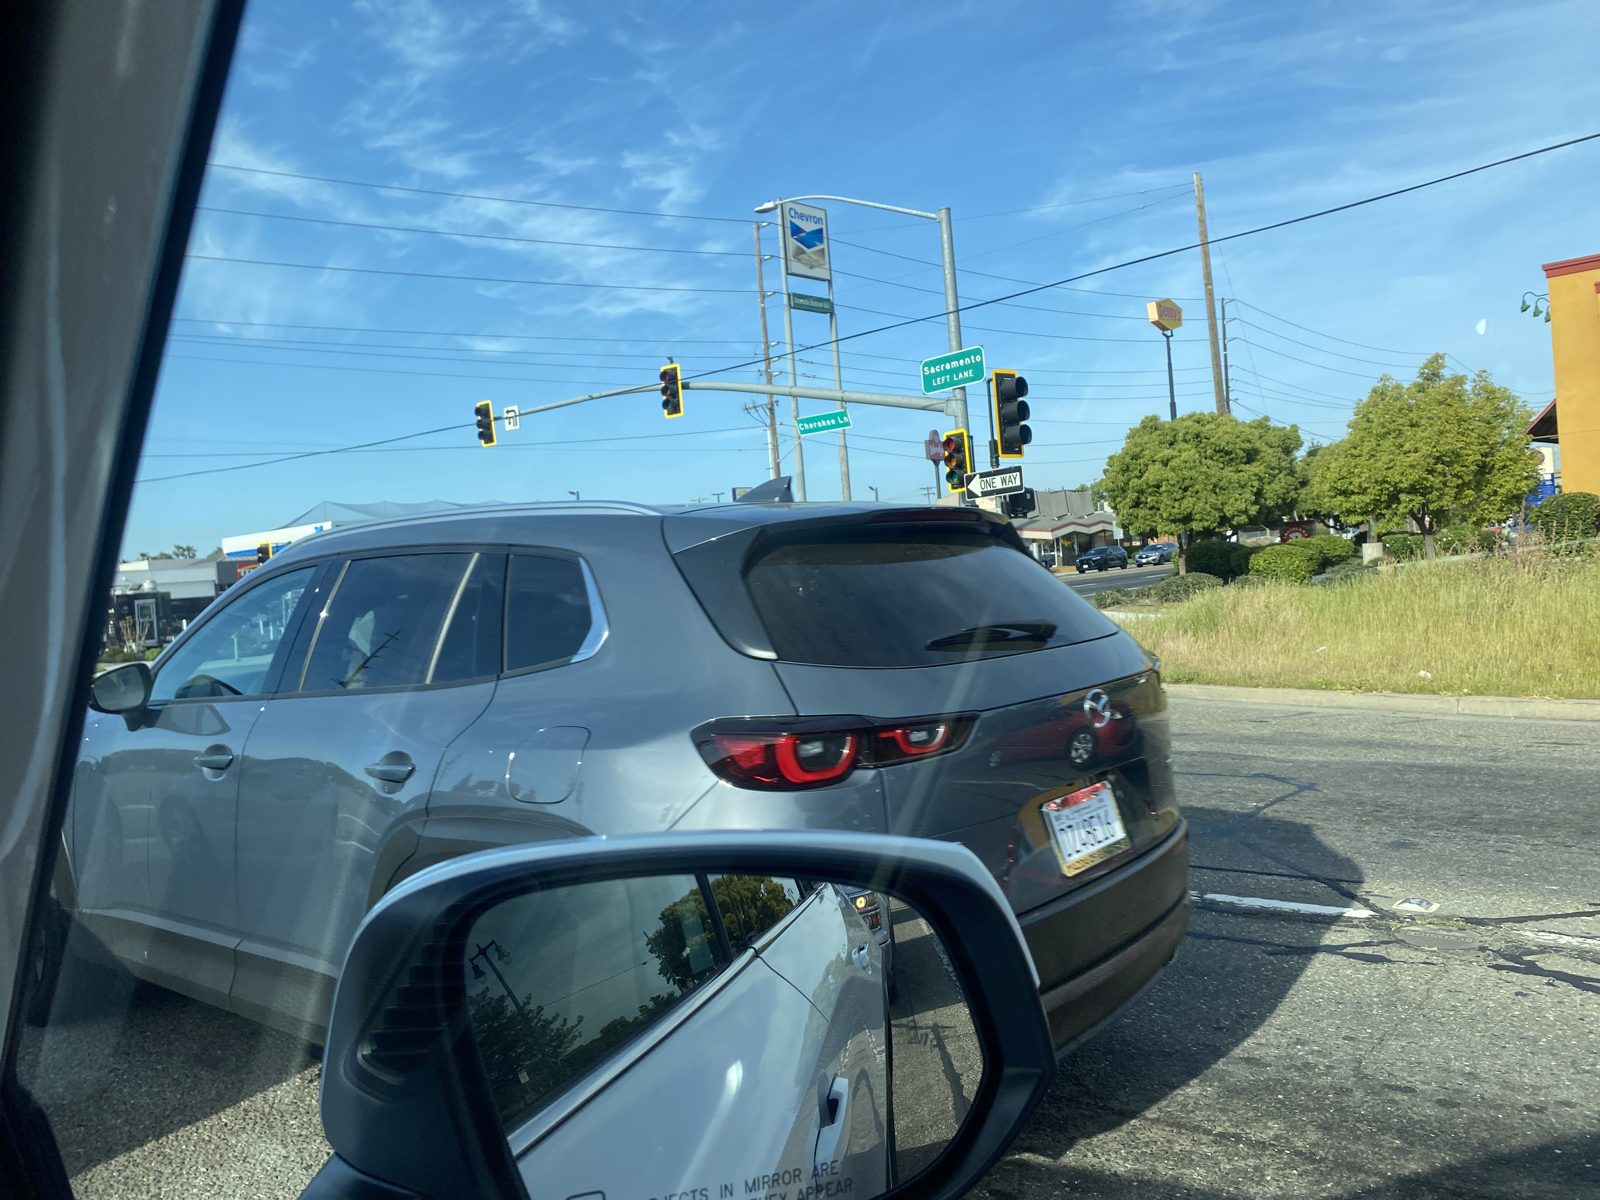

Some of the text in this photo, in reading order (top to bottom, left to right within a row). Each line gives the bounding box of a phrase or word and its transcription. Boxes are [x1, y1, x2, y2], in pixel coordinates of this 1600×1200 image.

[789, 207, 824, 226] Chevron
[923, 354, 982, 376] Sacramento
[932, 369, 975, 387] LEFT LANE
[798, 415, 849, 431] Cherokee Ln
[980, 473, 1018, 490] ONE WAY
[719, 1181, 734, 1200] IN
[744, 1167, 803, 1194] MIRROR
[811, 1160, 840, 1180] ARE
[796, 1178, 854, 1200] APPEAR
